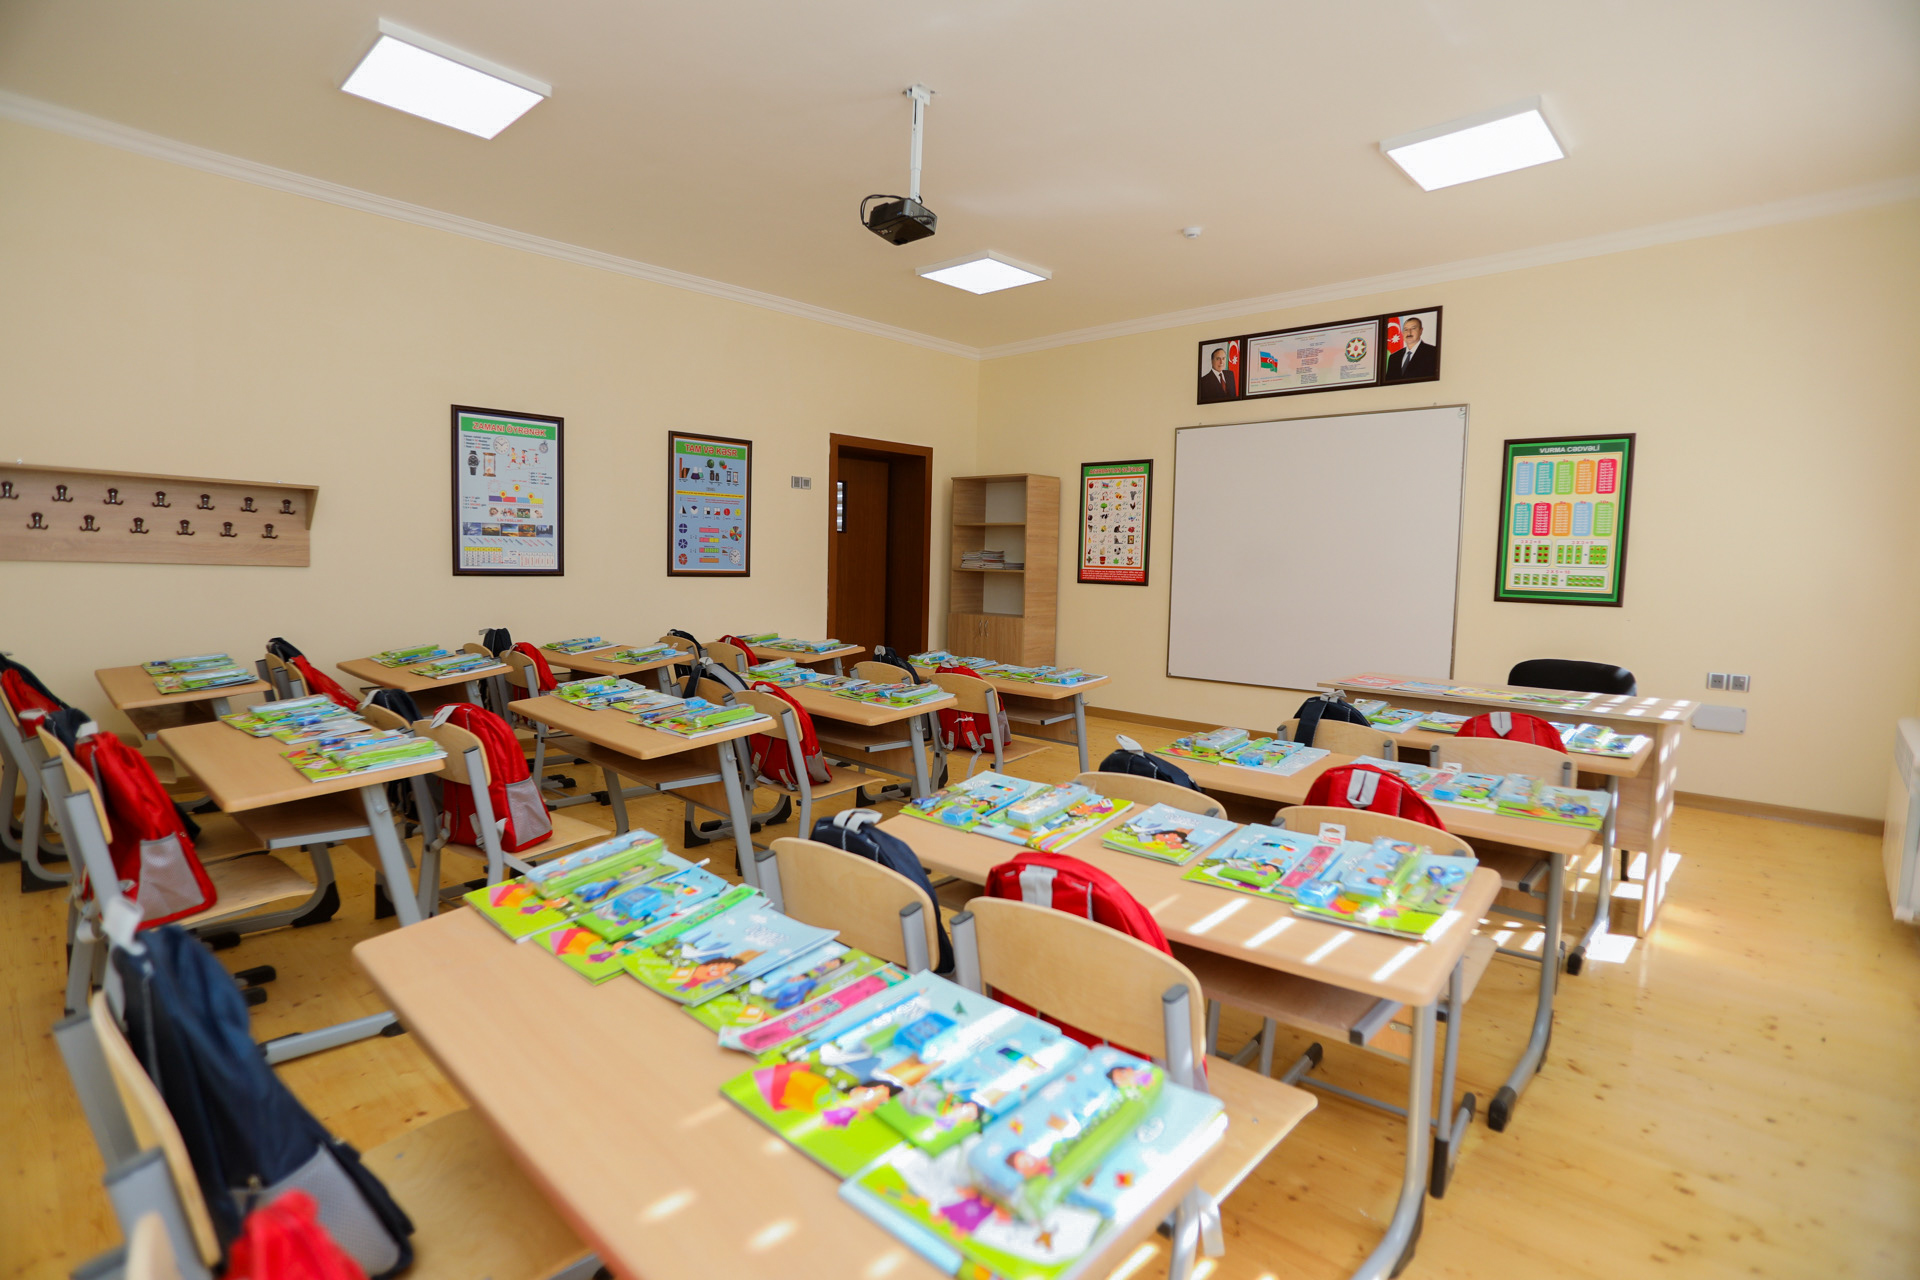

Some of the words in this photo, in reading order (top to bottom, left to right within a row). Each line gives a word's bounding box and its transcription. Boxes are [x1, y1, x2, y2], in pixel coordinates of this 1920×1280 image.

[472, 422, 504, 432] ZAMANI
[506, 424, 546, 436] ÖYRƏNƏK
[685, 444, 701, 453] TAM
[704, 446, 714, 454] VƏ
[716, 448, 738, 456] KƏSR
